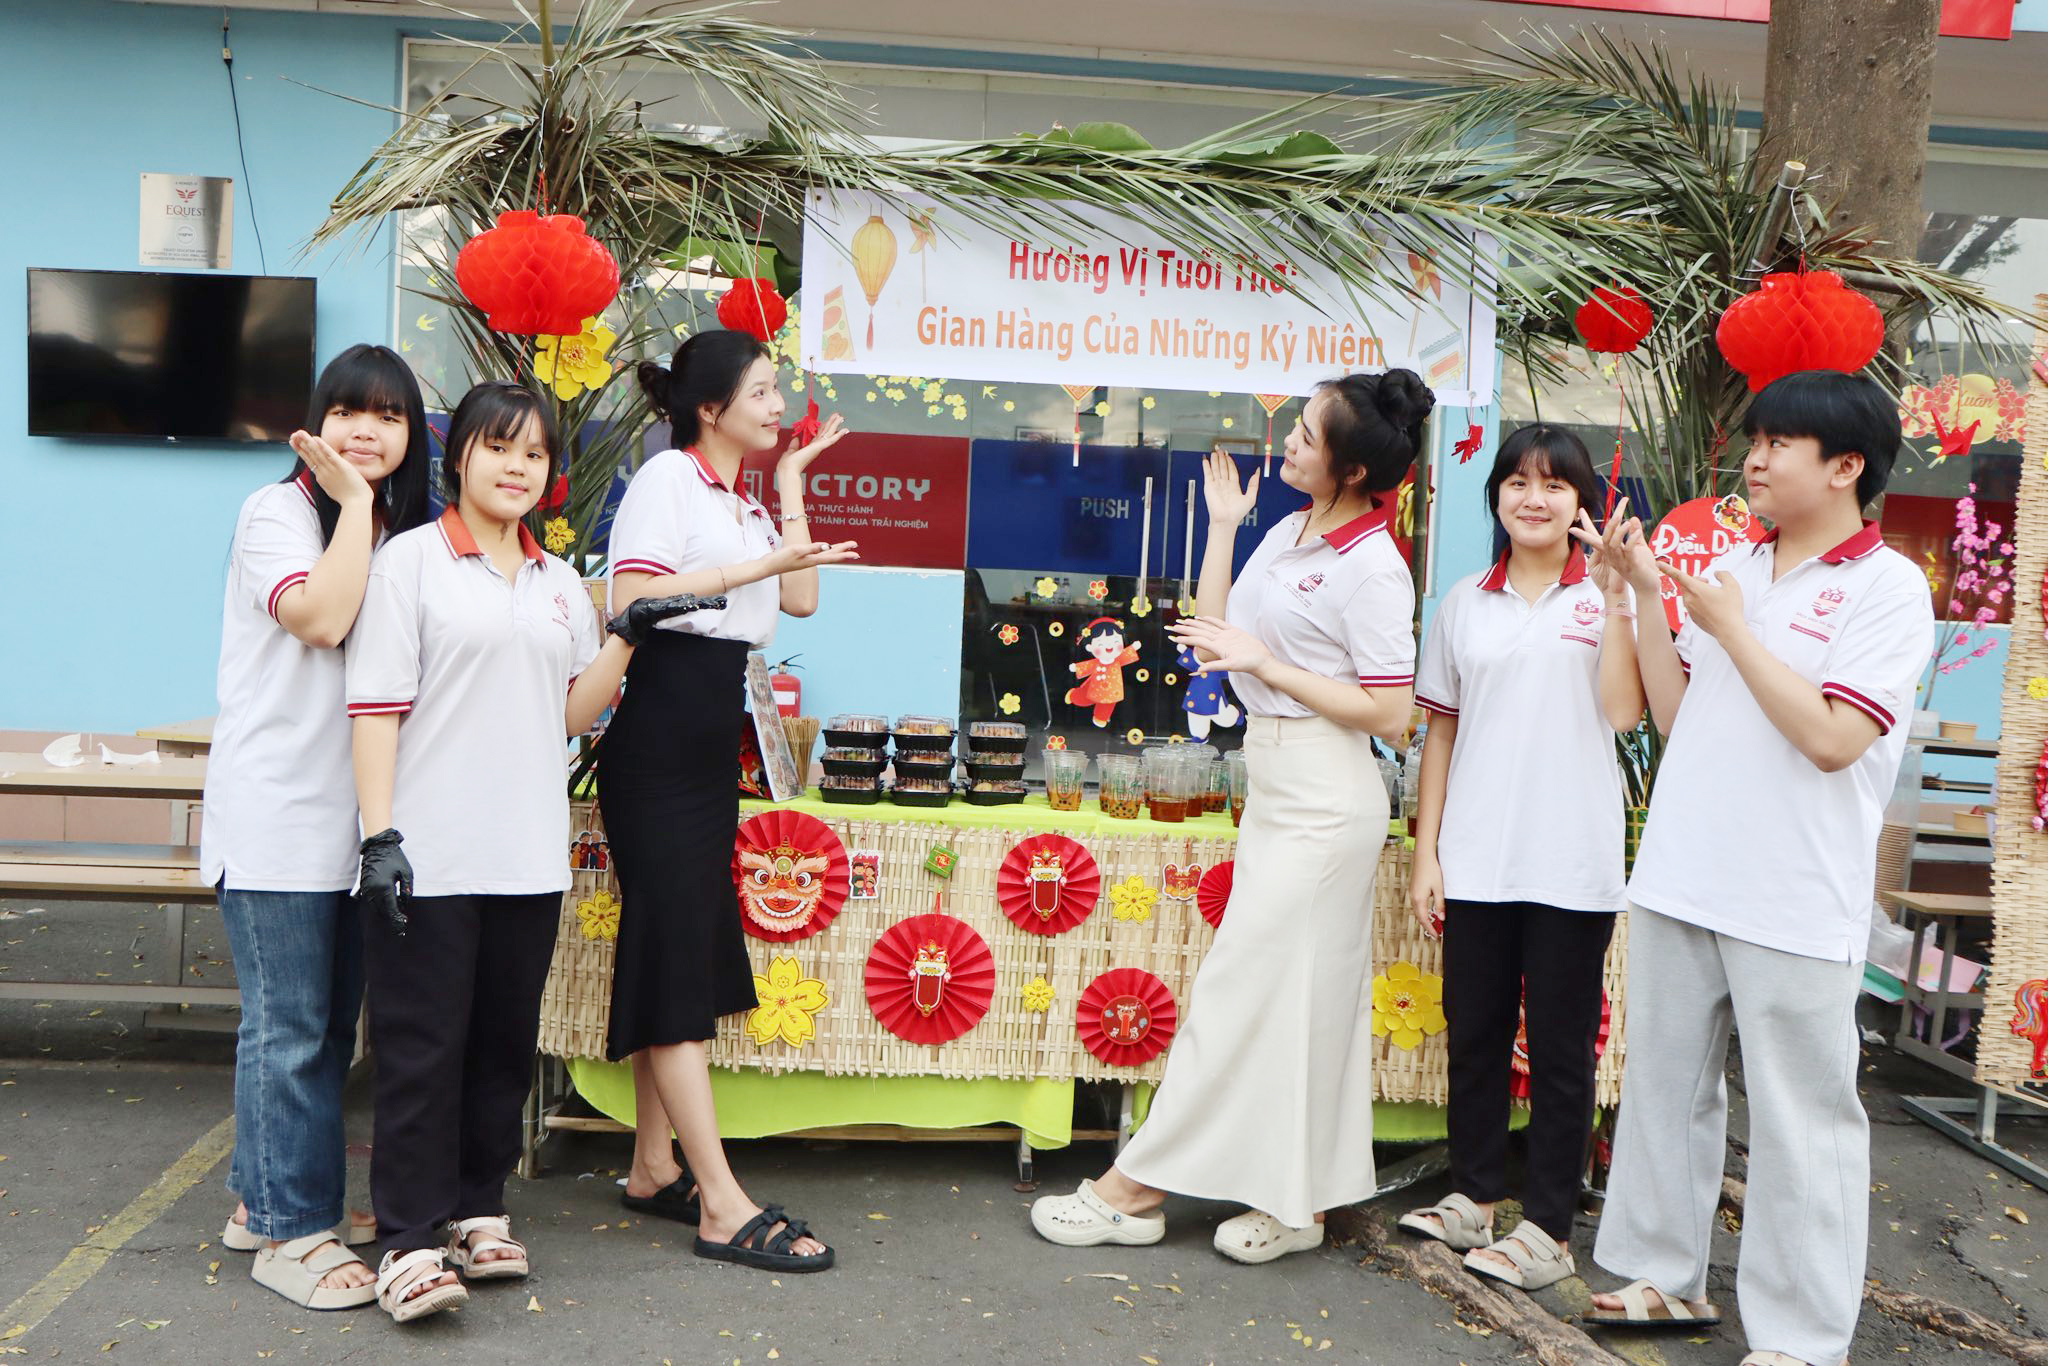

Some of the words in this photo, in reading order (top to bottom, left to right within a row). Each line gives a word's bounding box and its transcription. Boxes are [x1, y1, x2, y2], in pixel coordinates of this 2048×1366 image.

[1009, 241, 1110, 294] Hương
[1120, 247, 1148, 296] Vị
[917, 306, 985, 347] Gian
[996, 307, 1074, 361] Hàng
[1083, 312, 1139, 355] Của
[1149, 318, 1250, 371] Những
[1260, 320, 1298, 372] Kỷ
[1306, 322, 1384, 377] Niệm
[848, 517, 868, 526] QUA
[1080, 497, 1129, 519] PUSH
